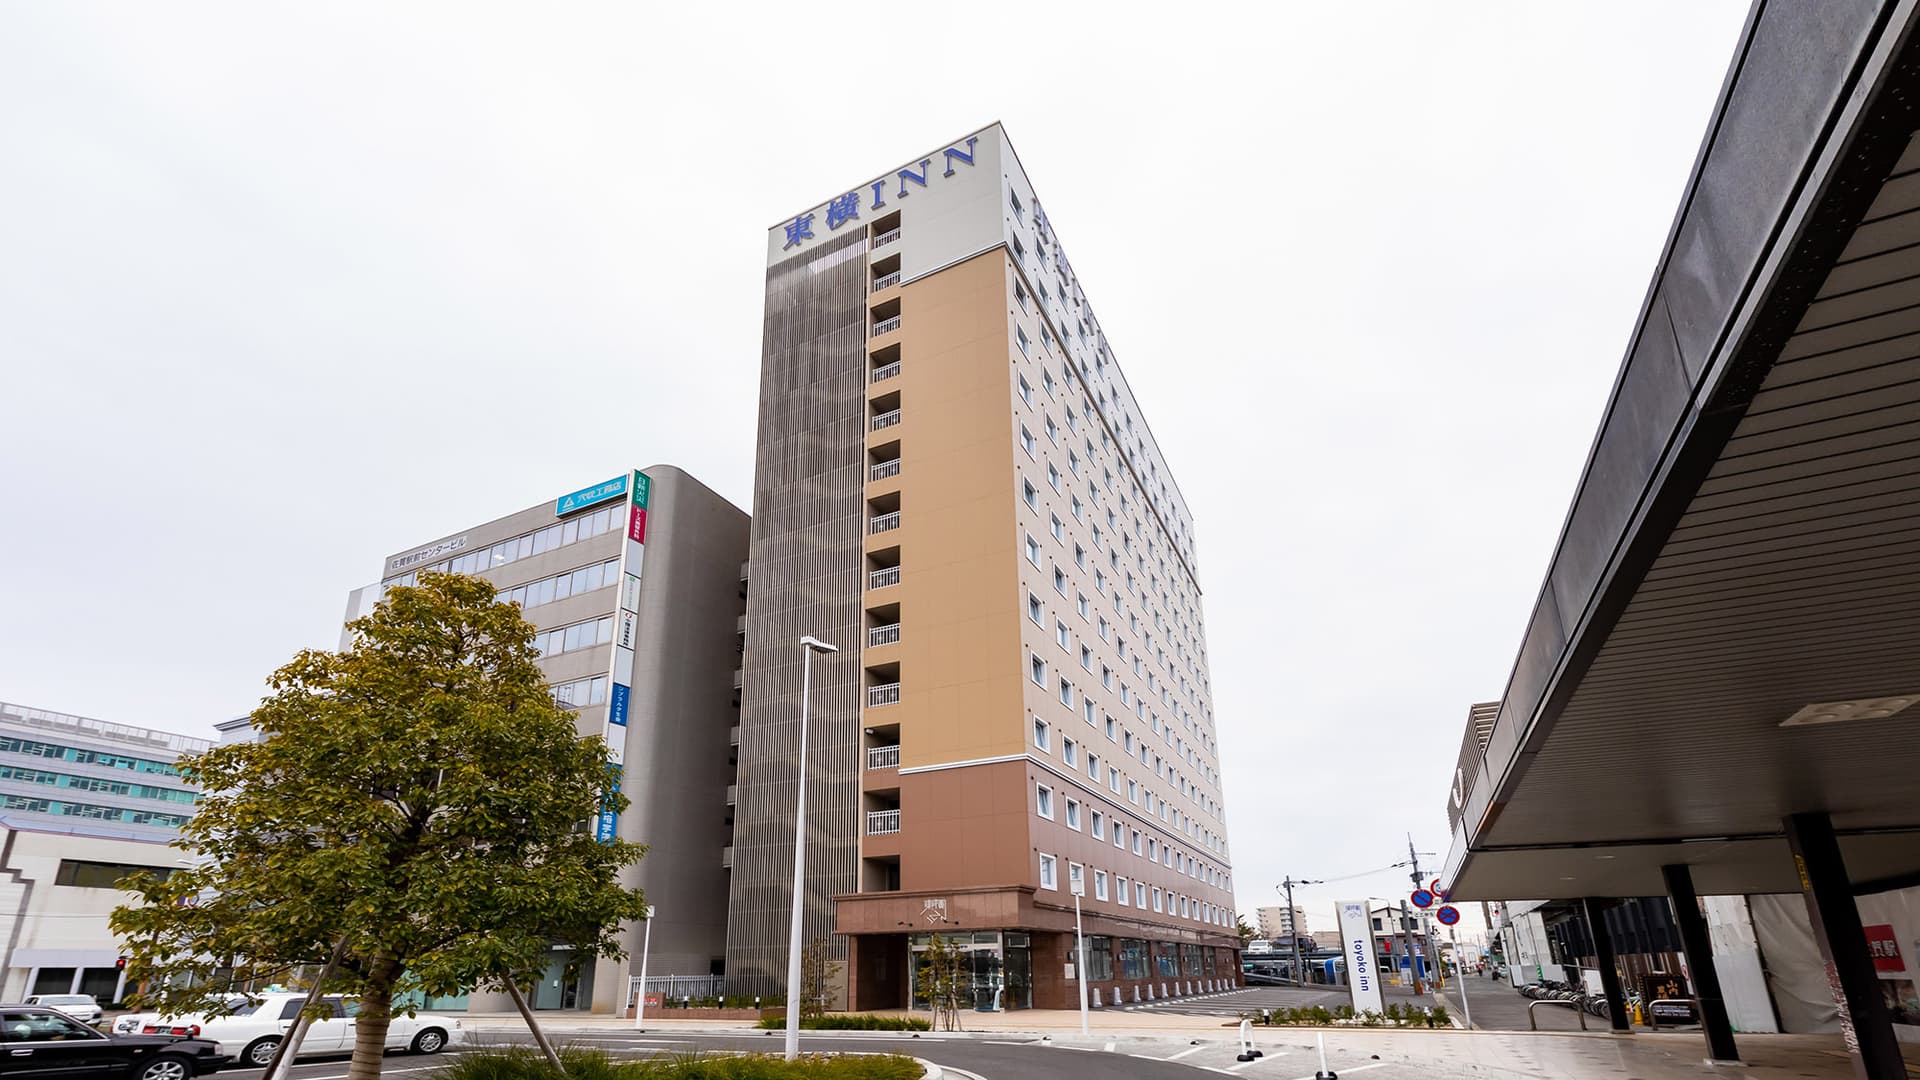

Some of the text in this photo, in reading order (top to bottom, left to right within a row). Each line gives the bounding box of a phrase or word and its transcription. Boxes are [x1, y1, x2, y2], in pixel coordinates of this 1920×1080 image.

[782, 136, 979, 251] 東横INN
[1353, 939, 1370, 992] toyoko inn
